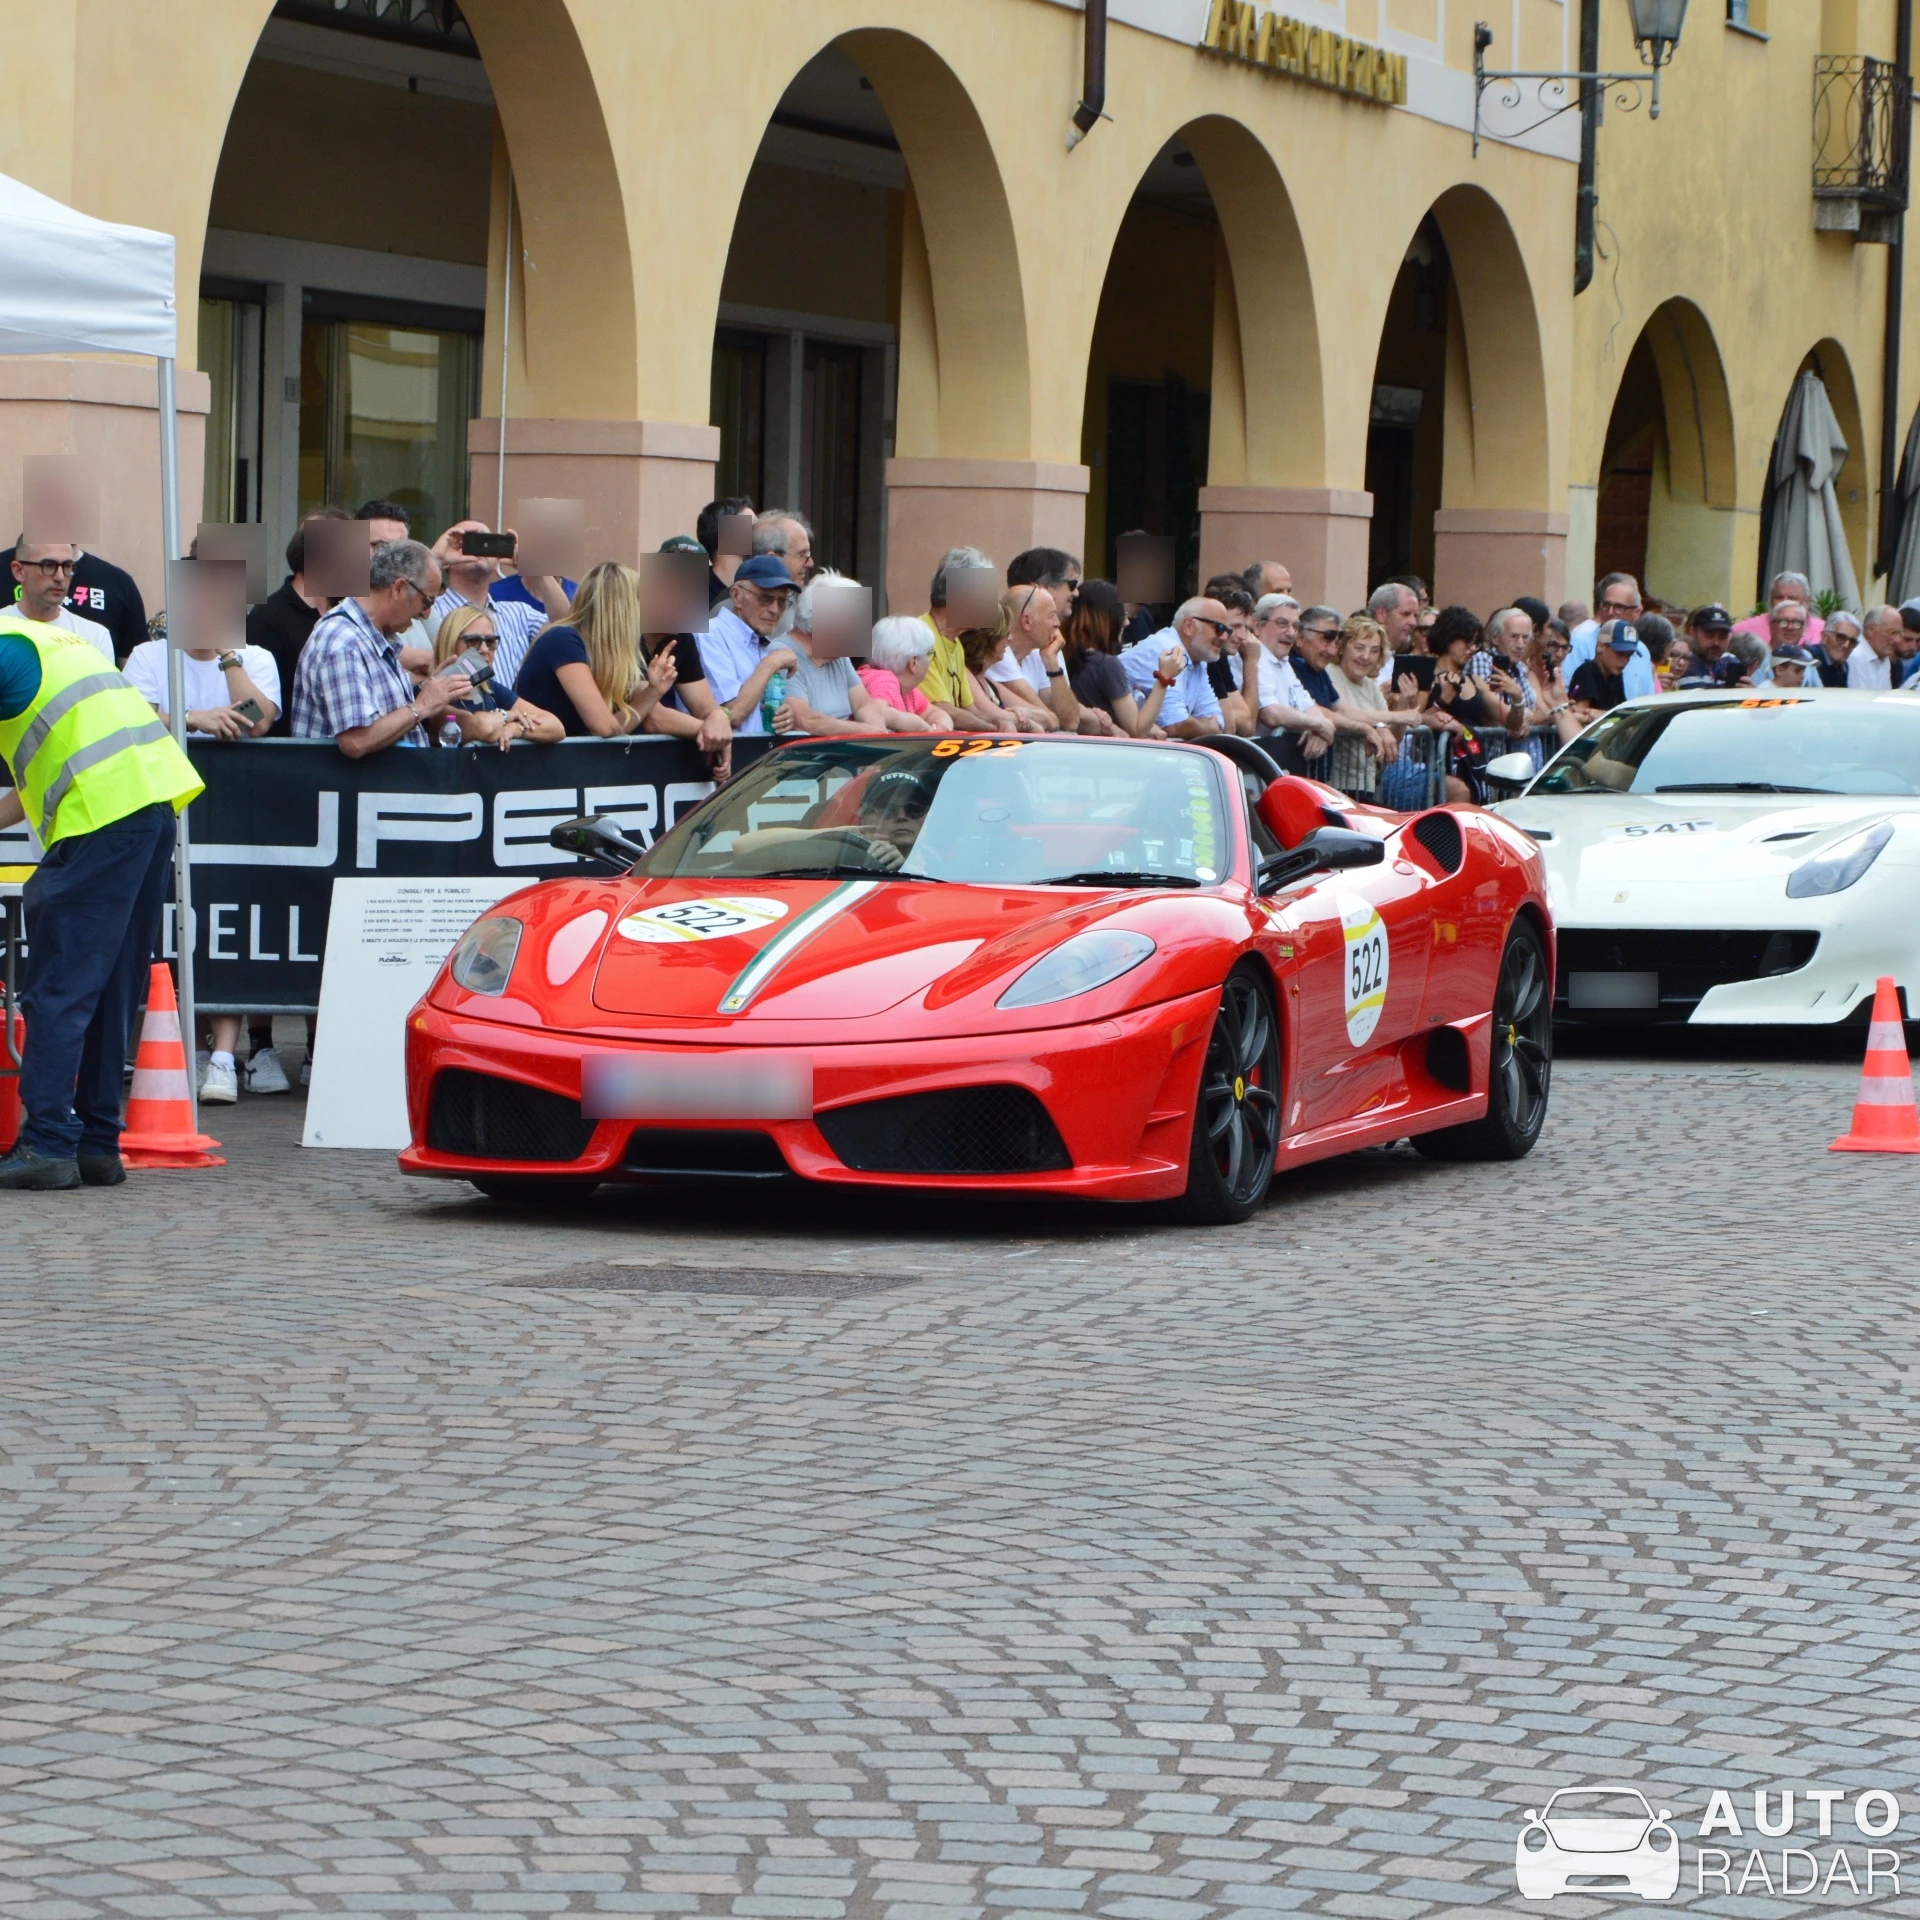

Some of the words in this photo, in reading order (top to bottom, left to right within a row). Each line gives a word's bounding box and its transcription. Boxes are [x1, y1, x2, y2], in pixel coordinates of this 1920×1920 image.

[1740, 699, 1799, 709] 541
[931, 740, 1023, 757] 522
[1625, 822, 1697, 837] 541
[656, 905, 747, 933] 522
[1352, 937, 1392, 999] 522
